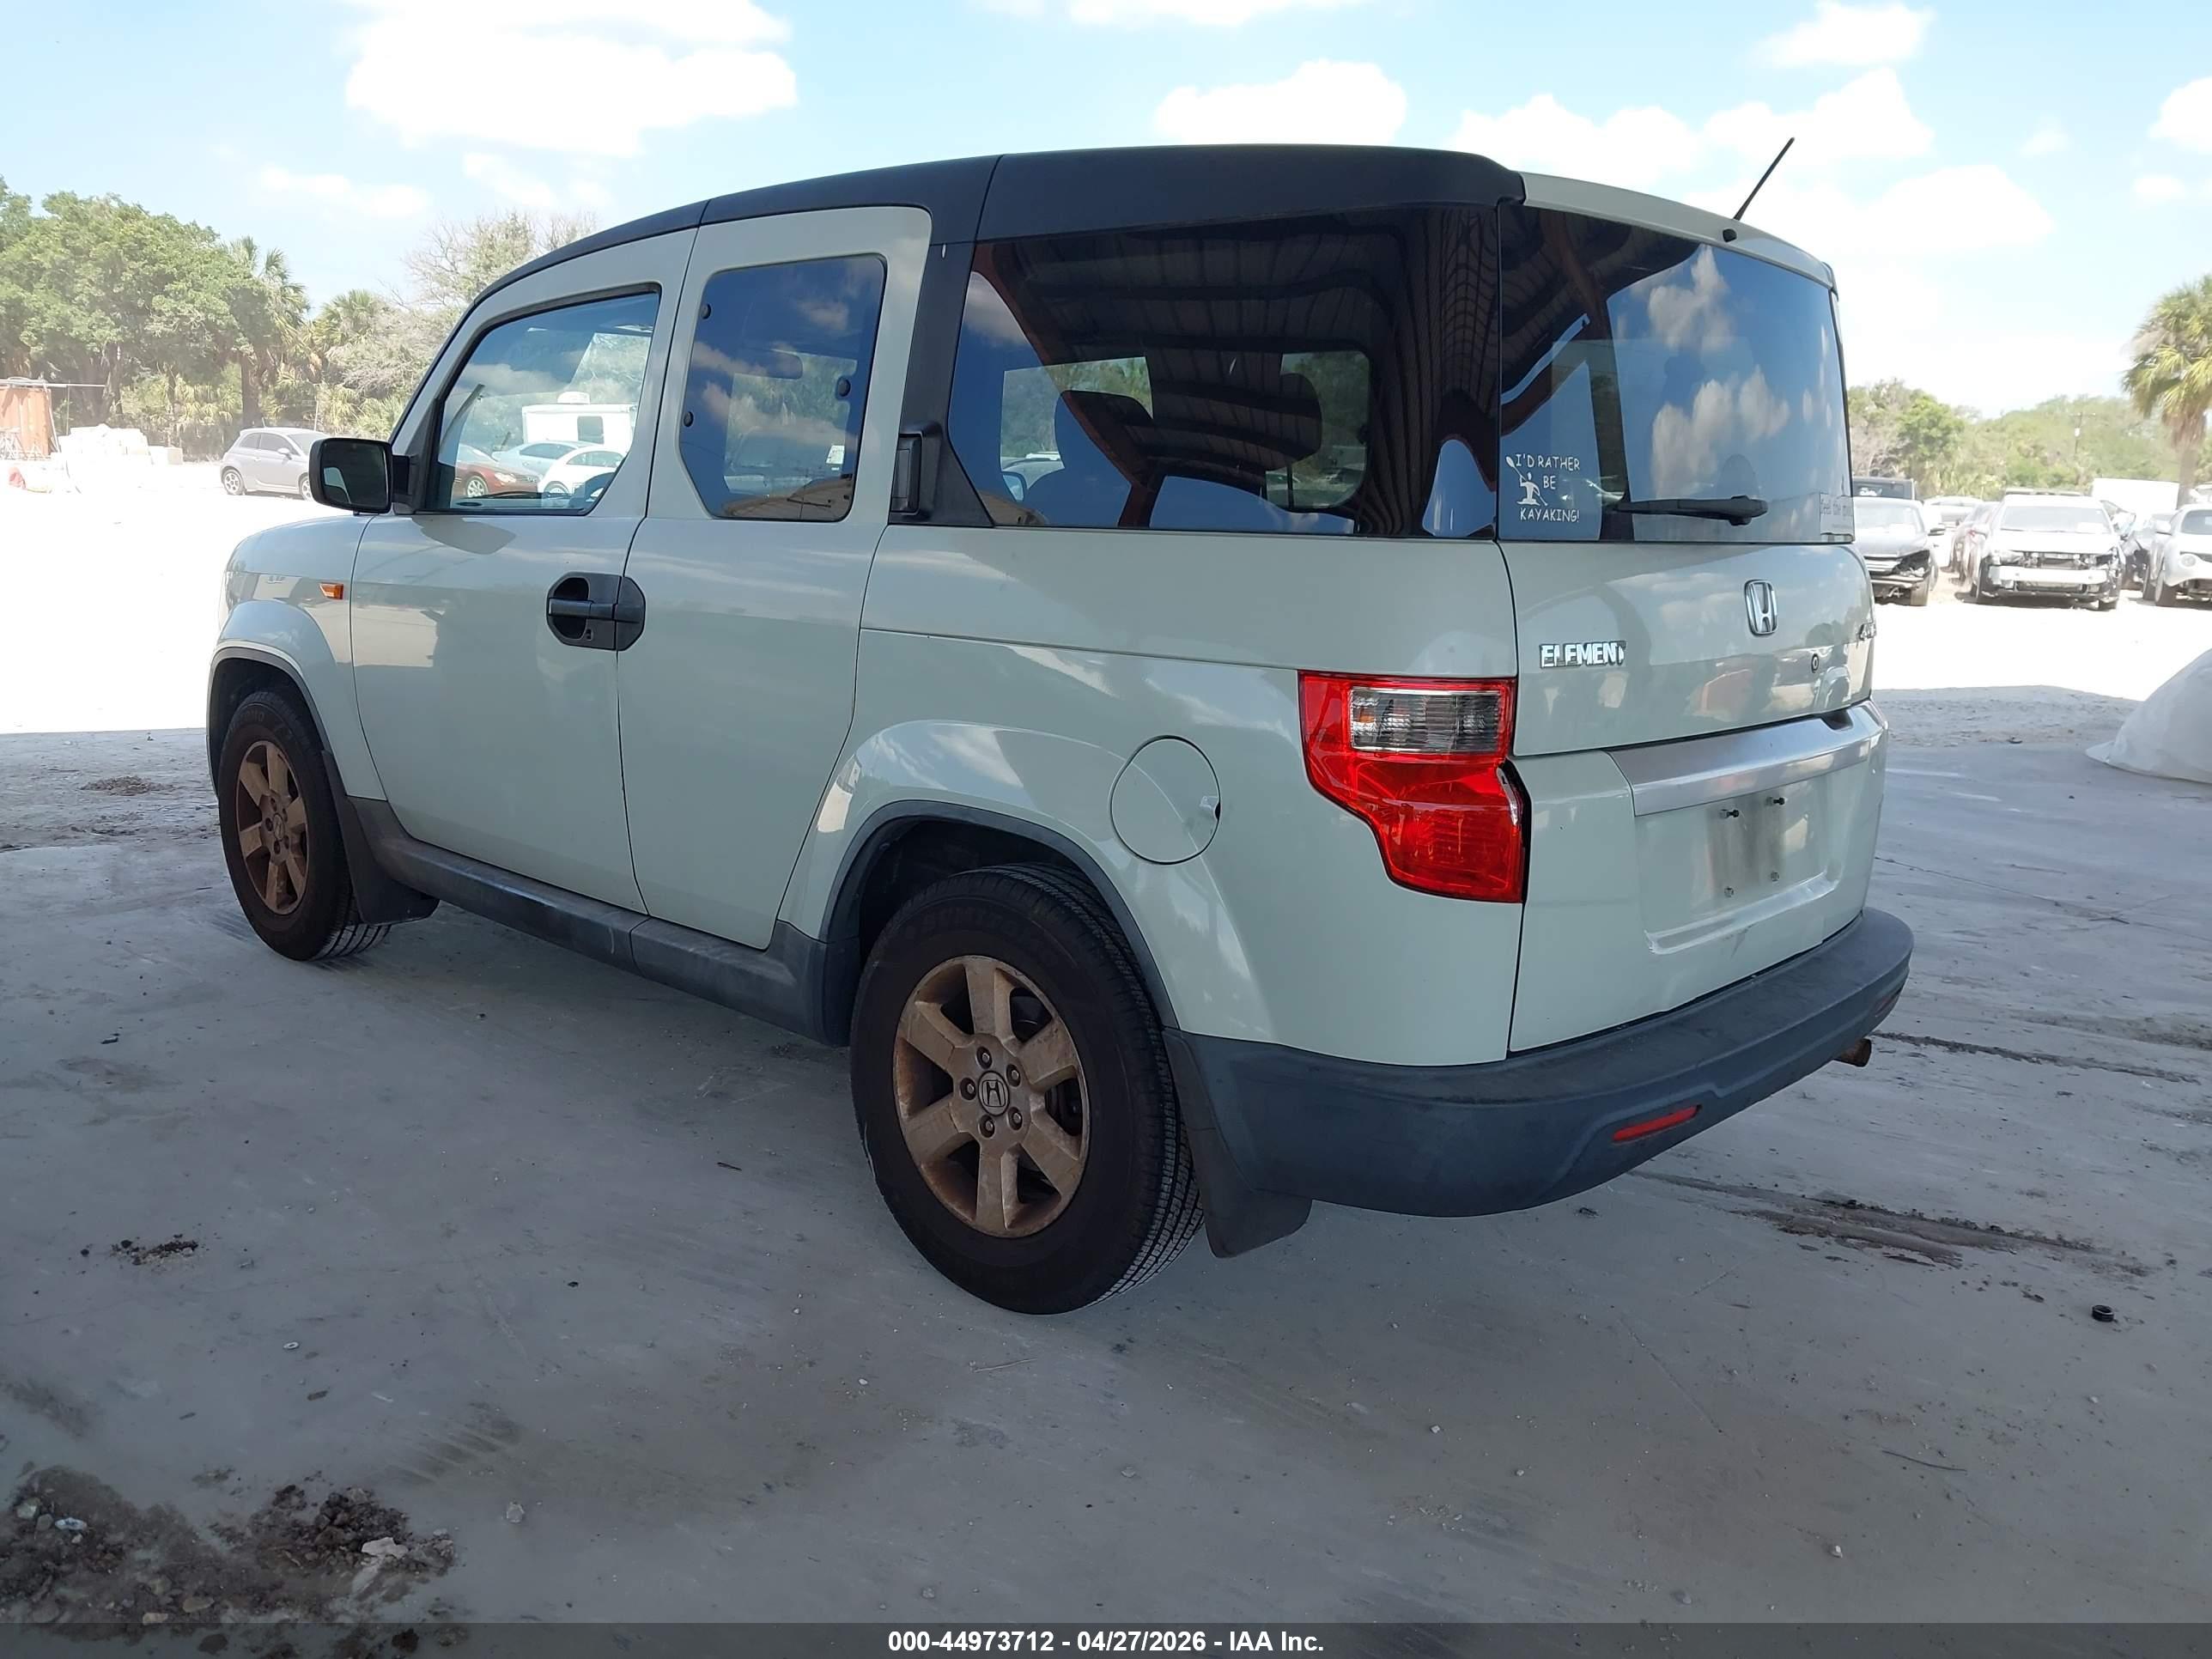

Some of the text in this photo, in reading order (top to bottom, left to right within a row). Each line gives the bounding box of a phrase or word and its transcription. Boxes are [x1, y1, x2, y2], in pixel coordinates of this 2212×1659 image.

[1516, 453, 1580, 471] I'D RATHER
[1543, 475, 1556, 489] BE
[1520, 507, 1580, 523] KAYAKING!
[1540, 641, 1626, 668] ELEMENT
